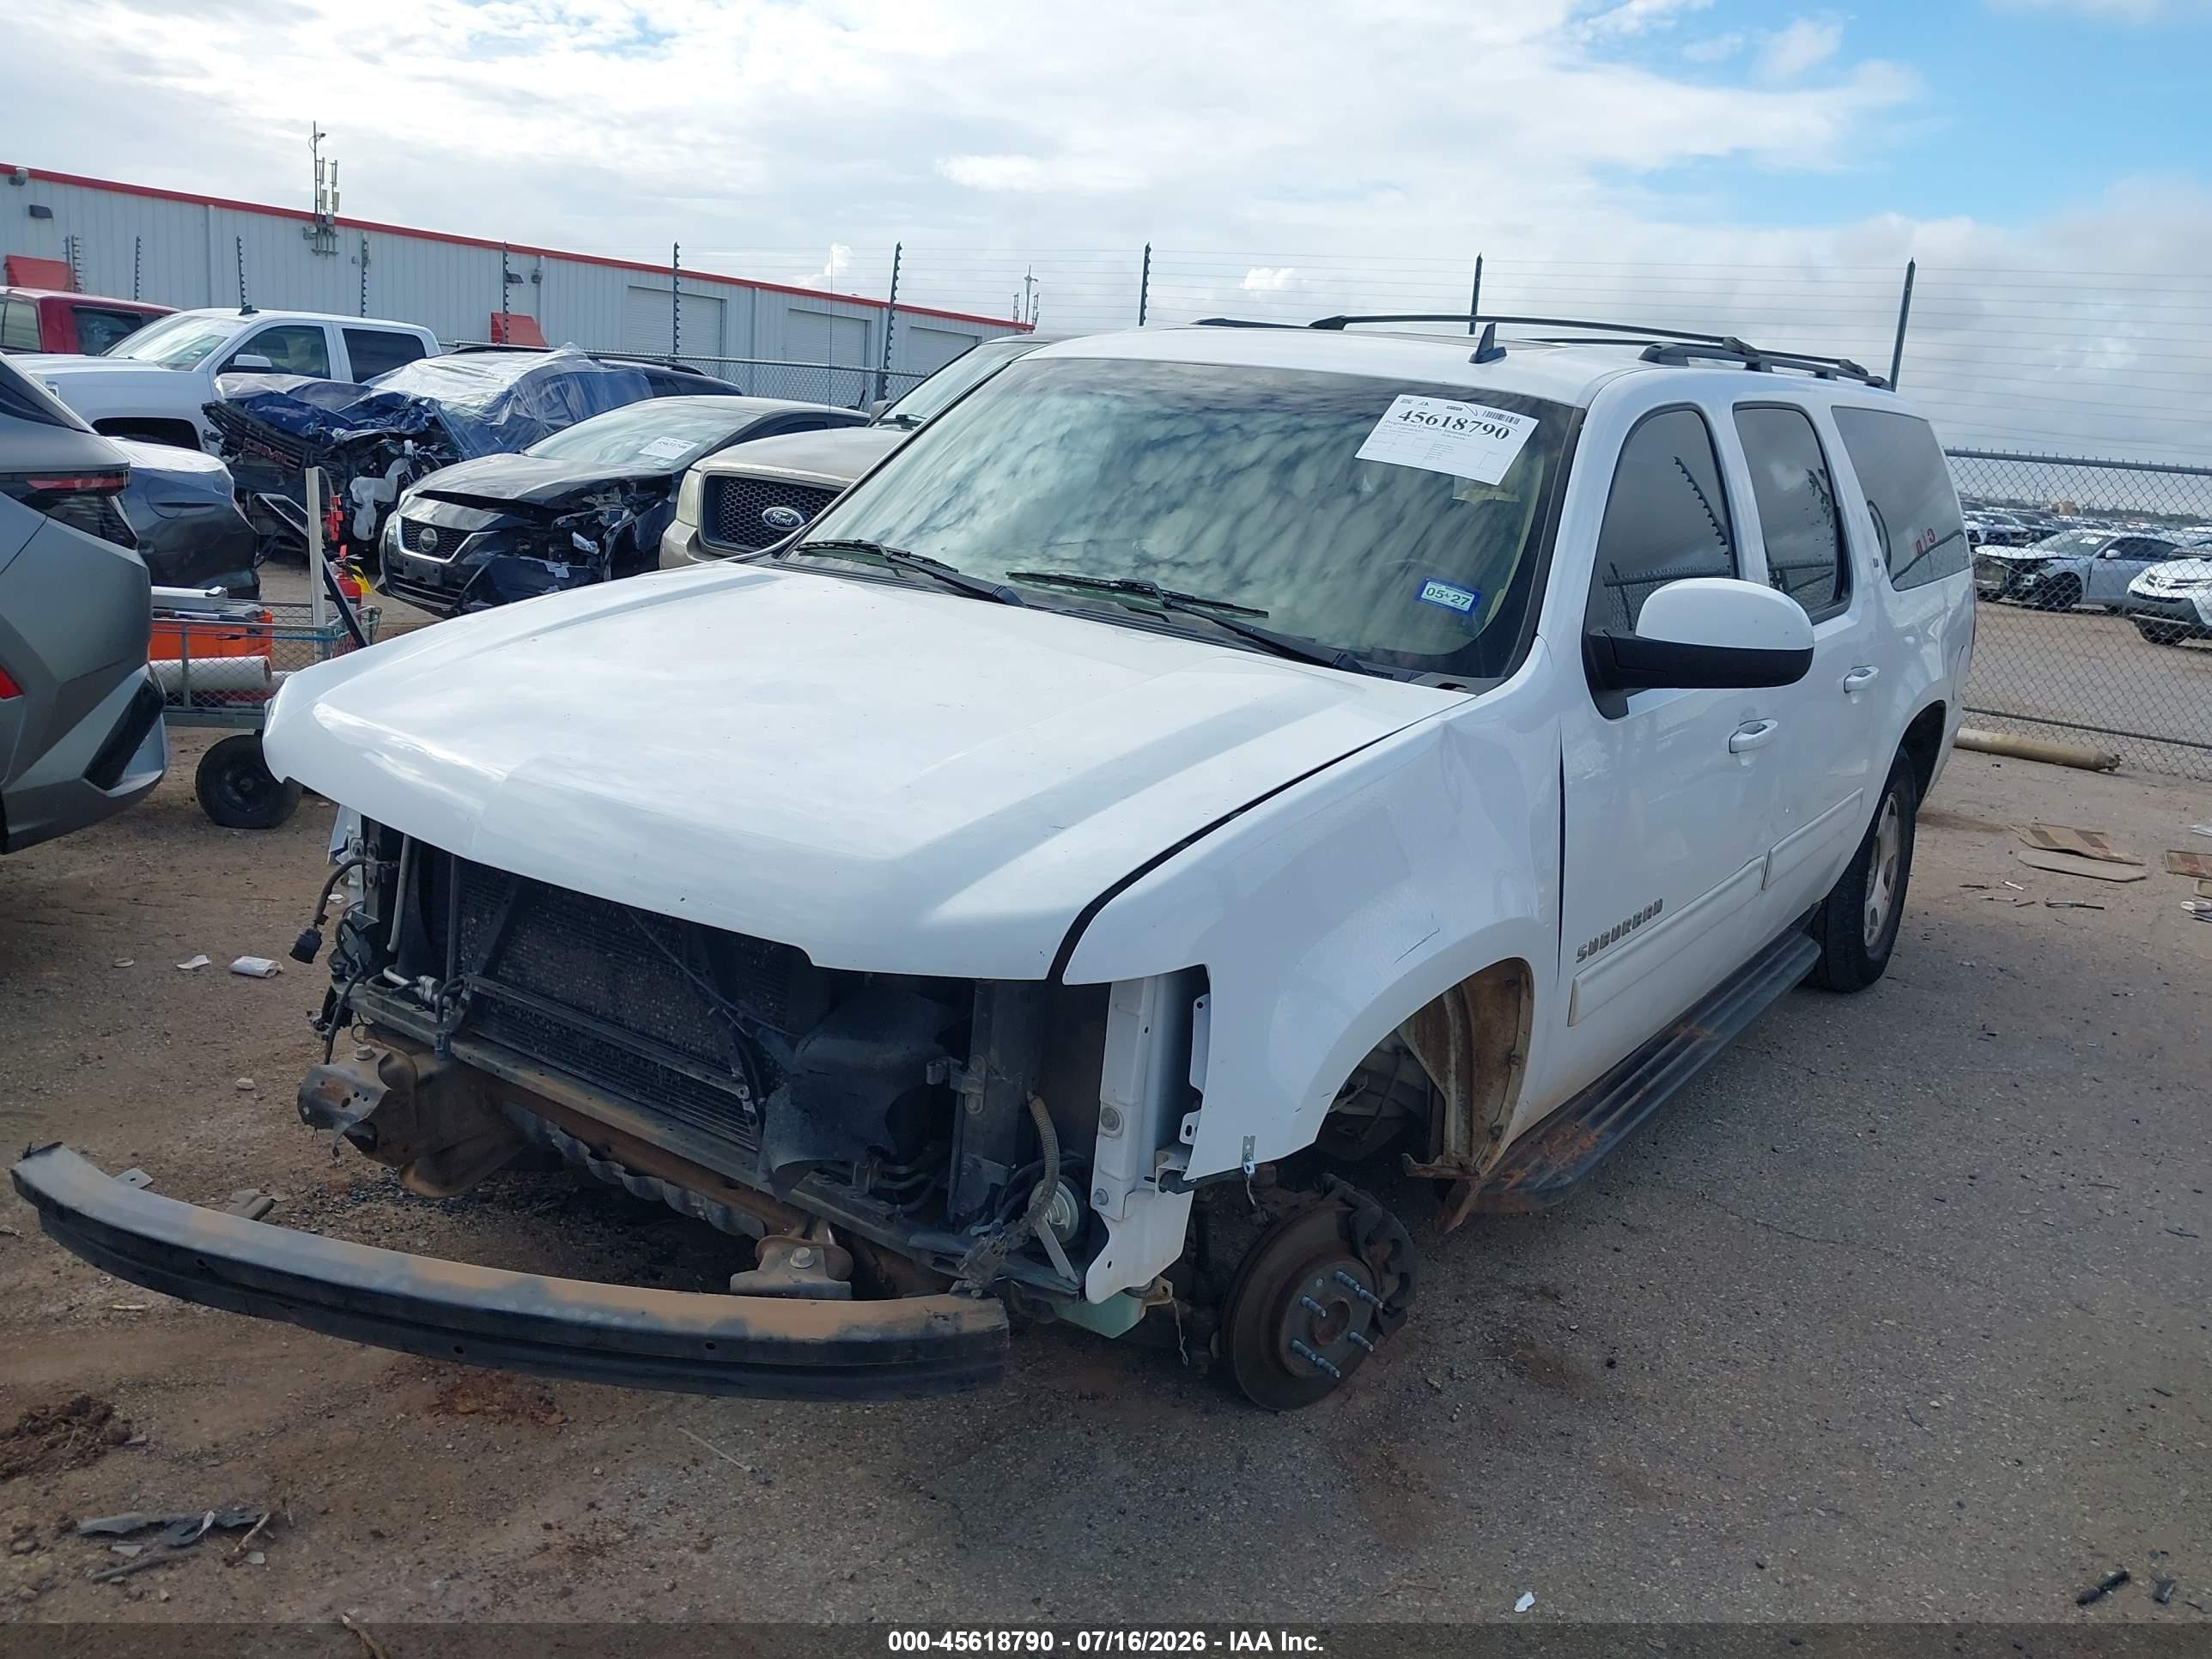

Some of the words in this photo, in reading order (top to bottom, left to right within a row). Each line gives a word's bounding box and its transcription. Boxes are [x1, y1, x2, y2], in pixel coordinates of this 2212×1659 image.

[1397, 409, 1510, 441] 45618790
[242, 438, 300, 469] GMC
[770, 511, 793, 525] Ford
[1576, 898, 1663, 963] SUBURBAN
